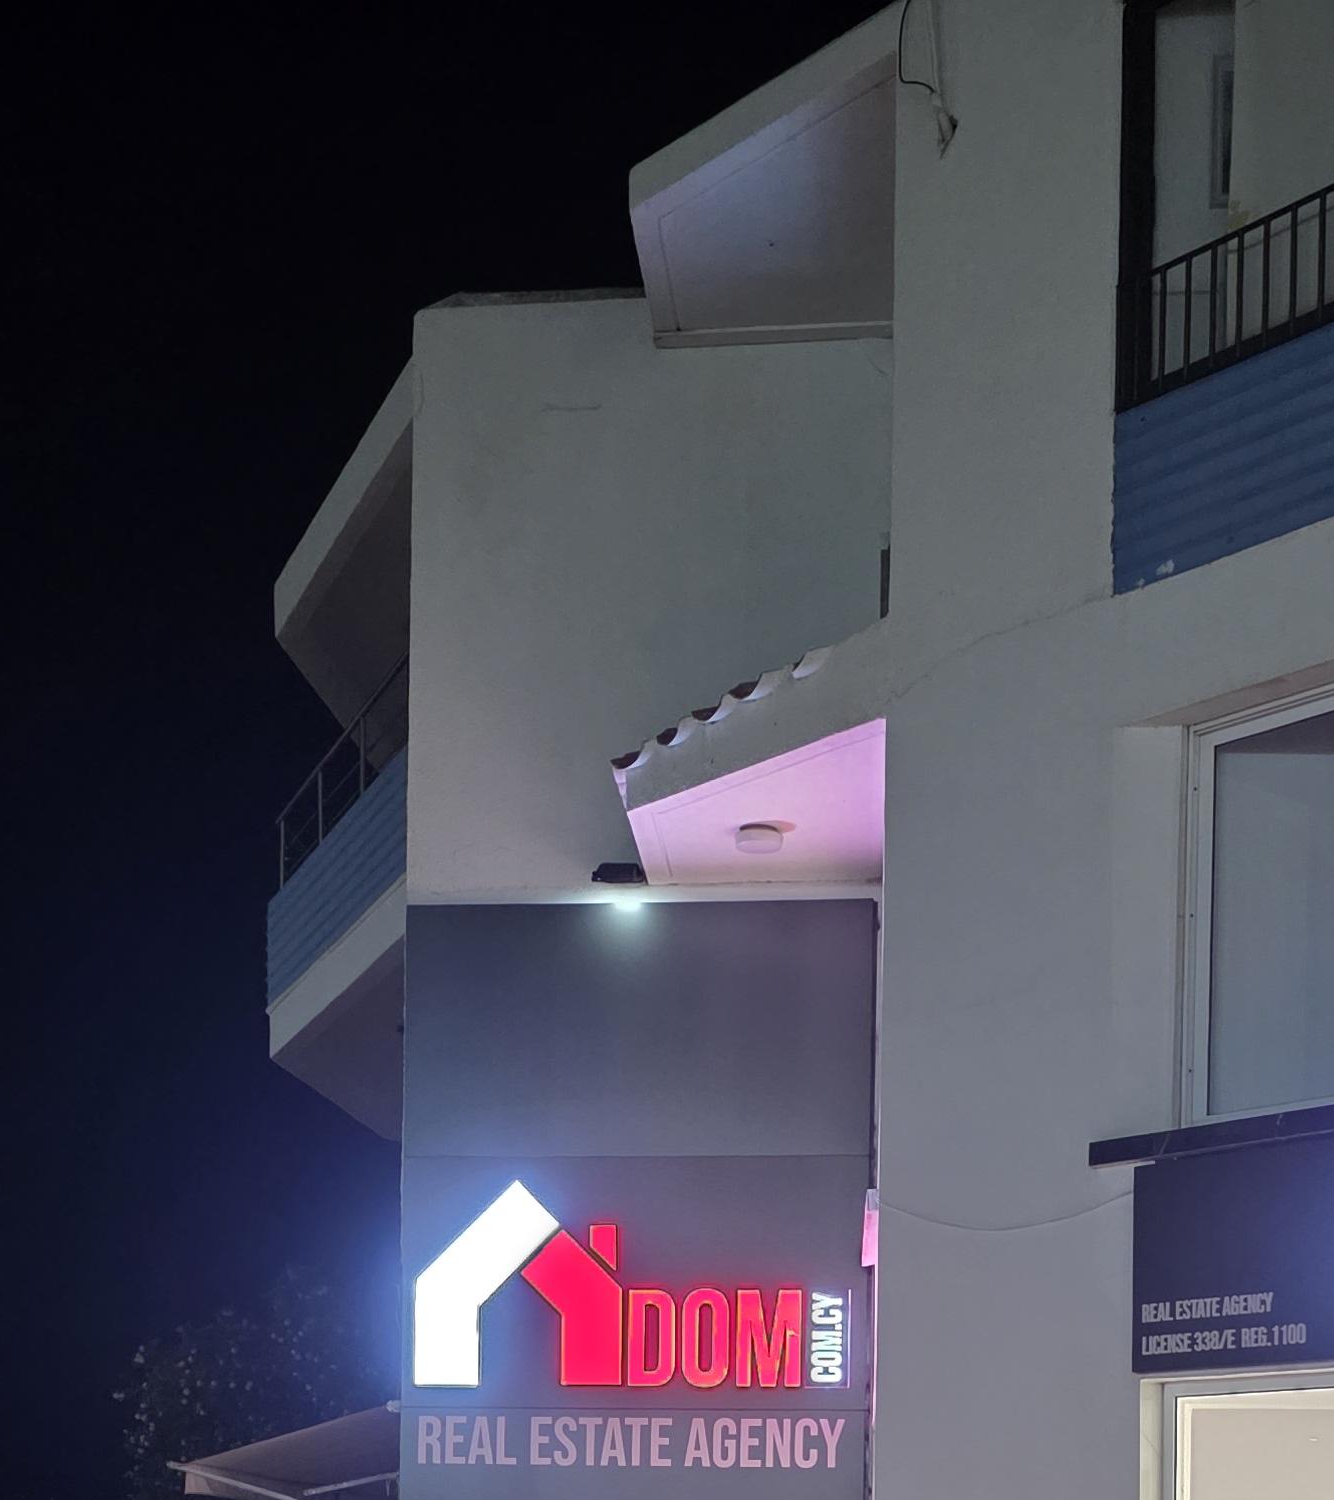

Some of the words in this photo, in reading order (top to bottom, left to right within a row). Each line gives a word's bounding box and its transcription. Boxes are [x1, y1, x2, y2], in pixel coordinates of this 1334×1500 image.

[1142, 1302, 1174, 1323] REAL
[1176, 1297, 1221, 1320] ESTATE
[1222, 1292, 1274, 1316] AGENCY
[810, 1292, 843, 1384] COM.CY
[1142, 1333, 1192, 1355] LICENSE
[1194, 1329, 1236, 1351] 338/E
[417, 1415, 517, 1466] REAL
[530, 1416, 672, 1467] ESTATE
[684, 1418, 845, 1469] AGENCY
